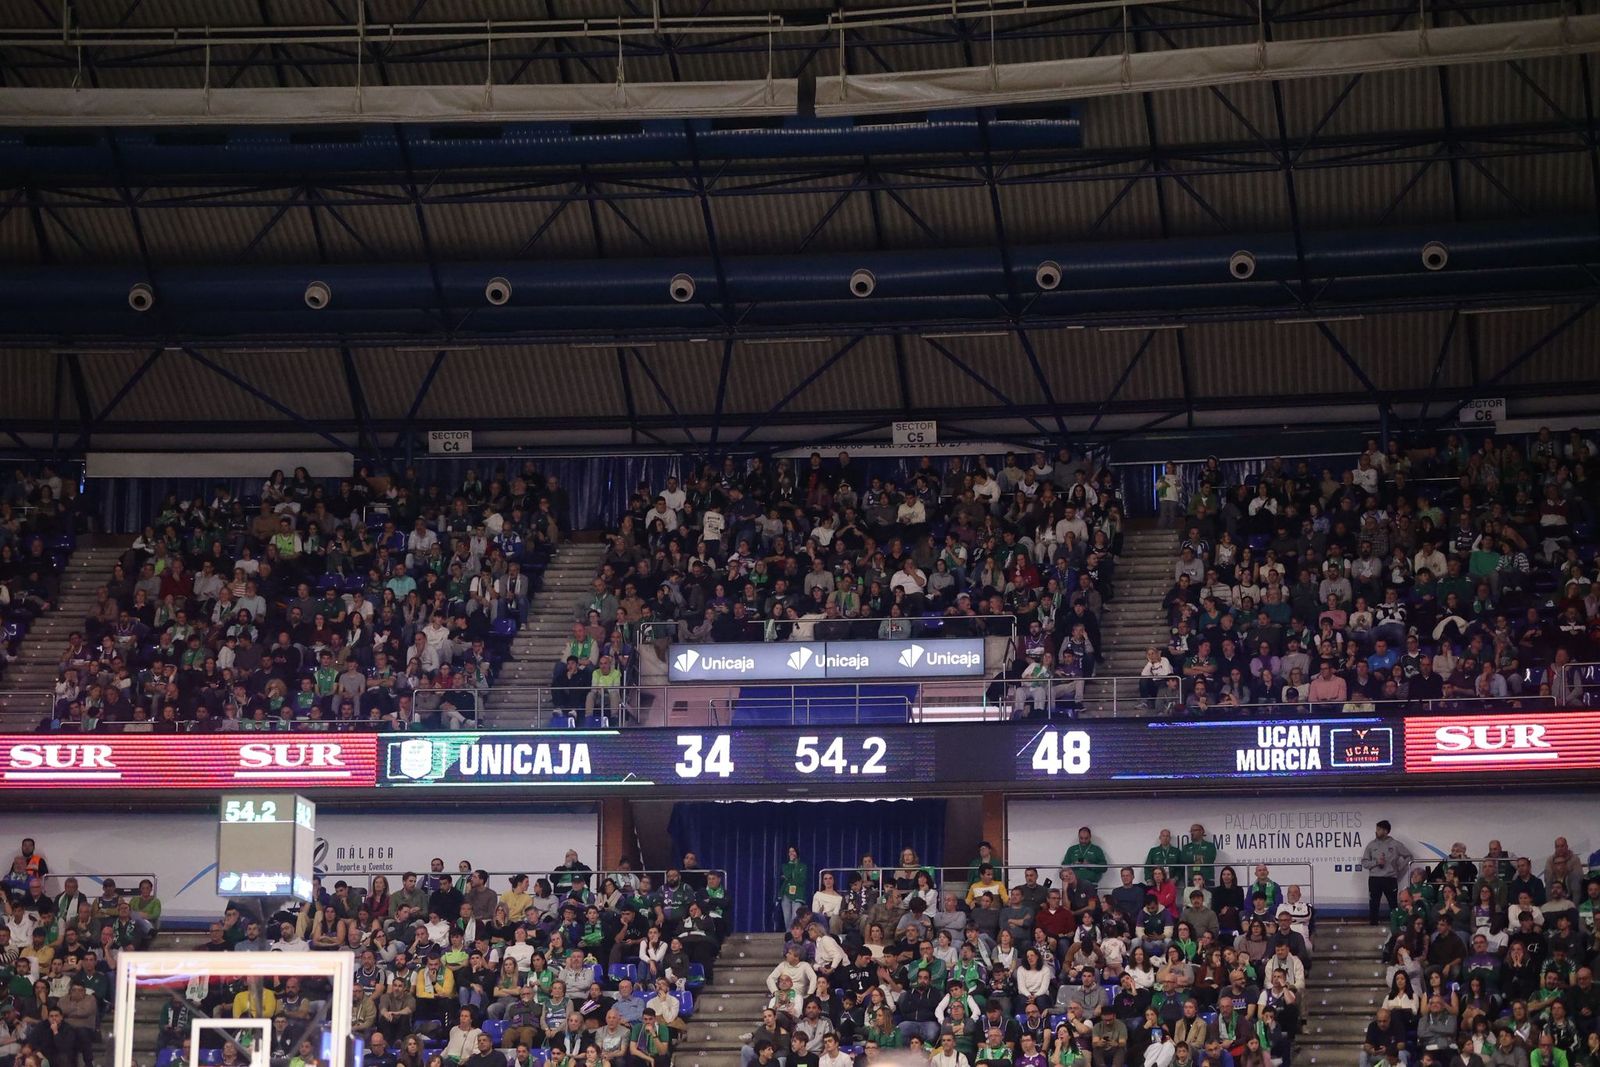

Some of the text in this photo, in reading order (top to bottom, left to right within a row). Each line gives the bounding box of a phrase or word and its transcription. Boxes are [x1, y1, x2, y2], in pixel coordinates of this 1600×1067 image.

[1475, 410, 1493, 421] C6
[431, 431, 470, 440] SECTOR
[895, 421, 934, 431] SECTOR
[443, 441, 460, 452] C4
[907, 432, 924, 443] C5
[701, 655, 755, 673] Unicaja
[815, 653, 869, 671] Unicaja
[926, 651, 981, 668] Unicaja
[1257, 725, 1321, 748] UCAM
[1434, 724, 1551, 751] SUR
[10, 743, 117, 769] SUR
[239, 743, 346, 768] SUR
[459, 742, 592, 775] UNICAJA
[675, 734, 735, 778] 34
[794, 736, 887, 774] 54.2
[1031, 730, 1091, 775] 48
[1236, 748, 1322, 772] MURCIA
[225, 800, 277, 821] 54.2
[1225, 811, 1362, 830] PALACIO DE DEPORTES
[1236, 829, 1291, 849] MARTÍN
[1295, 831, 1362, 849] CARPENA
[336, 845, 394, 860] MÁLAGA
[336, 862, 393, 874] Deporte y Eventos
